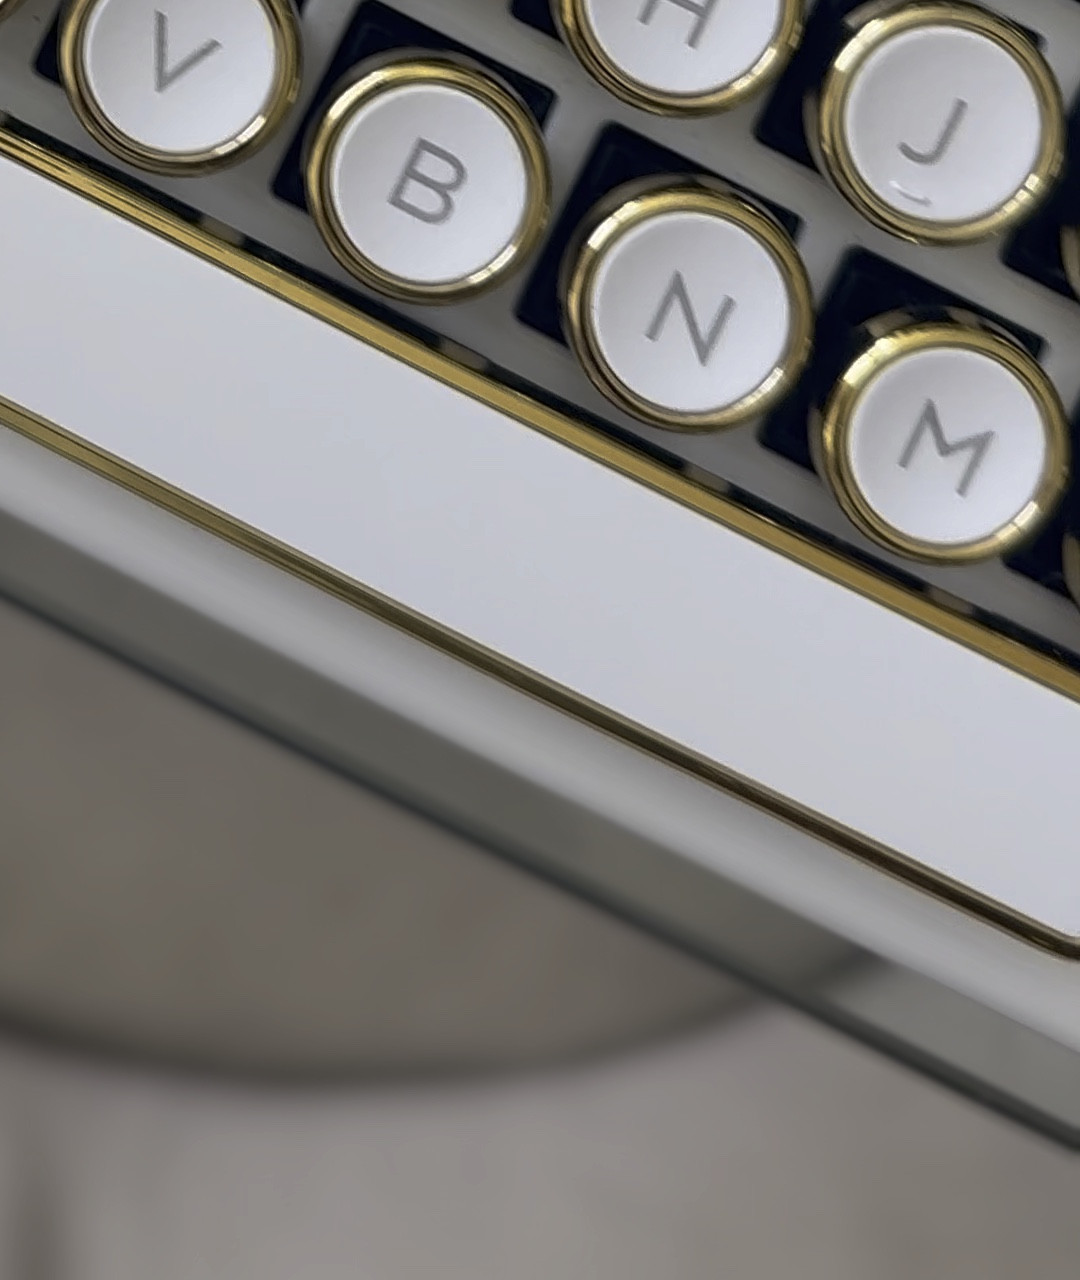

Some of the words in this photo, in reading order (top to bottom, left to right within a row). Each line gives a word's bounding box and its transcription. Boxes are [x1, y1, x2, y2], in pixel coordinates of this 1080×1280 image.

[154, 9, 222, 94] V
[896, 98, 969, 165] J
[387, 137, 469, 225] B
[645, 270, 738, 368] N
[897, 398, 997, 498] M
